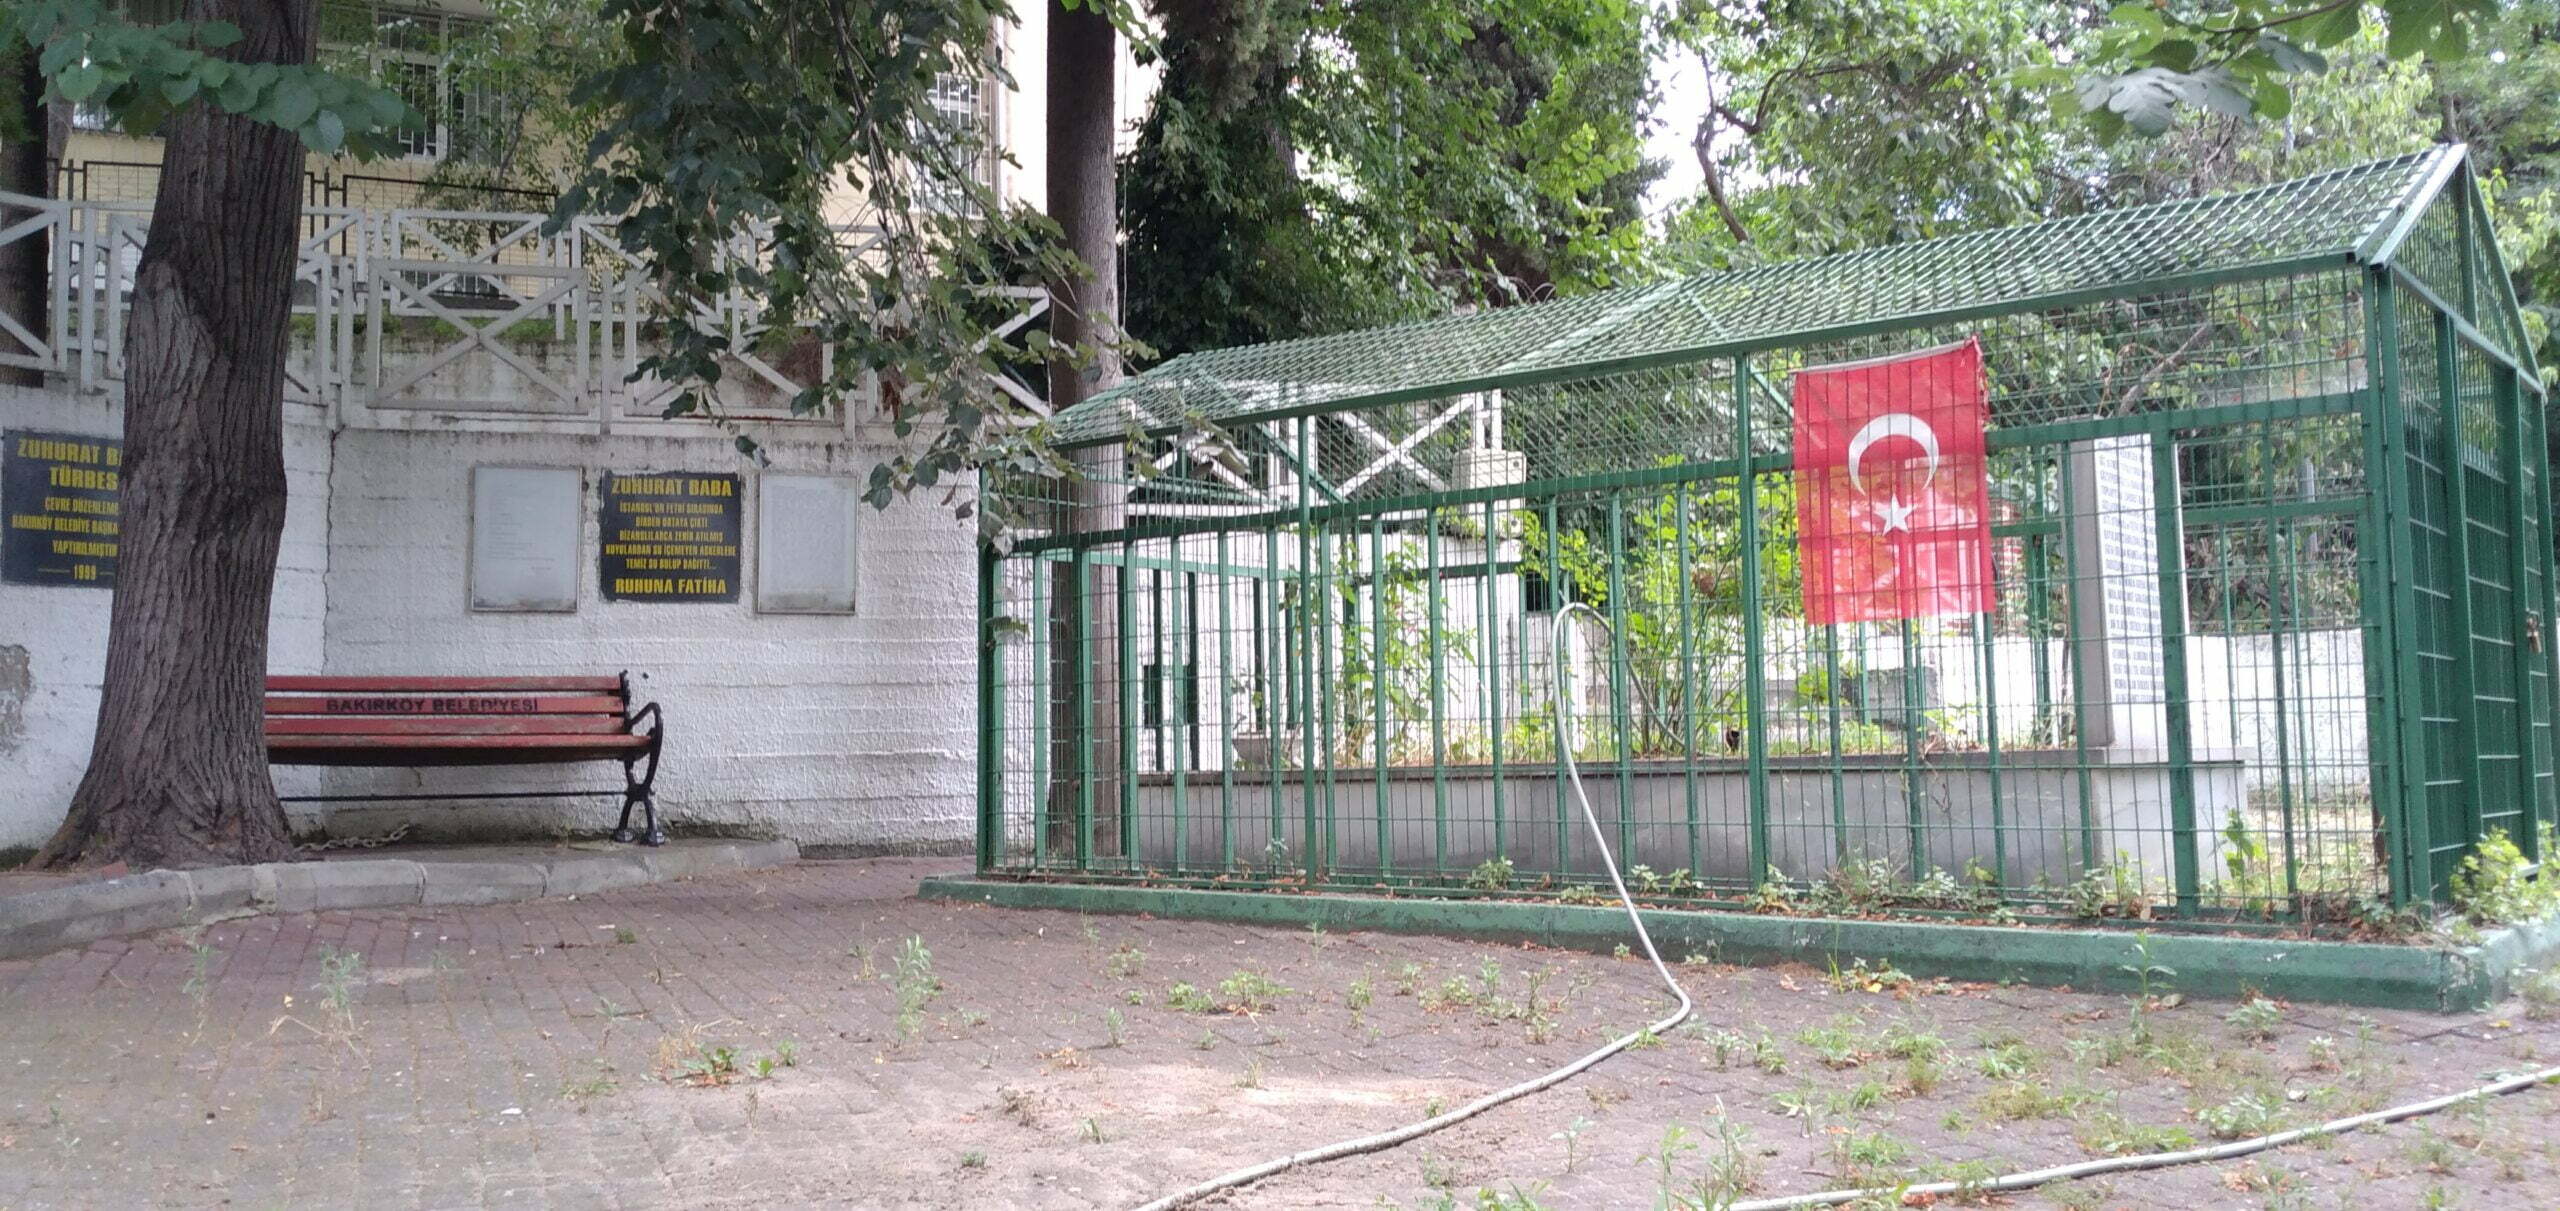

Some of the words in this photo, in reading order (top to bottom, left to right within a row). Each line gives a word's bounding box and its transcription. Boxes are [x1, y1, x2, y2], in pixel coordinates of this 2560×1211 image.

[17, 437, 100, 464] ZUHURAT
[611, 477, 683, 495] ZUHURAT
[688, 479, 732, 497] BABA
[662, 517, 688, 528] ORTAYA
[649, 558, 658, 569] SU
[660, 558, 681, 569] BULUP
[615, 578, 674, 593] RUHUNA
[679, 576, 727, 594] FATİHA
